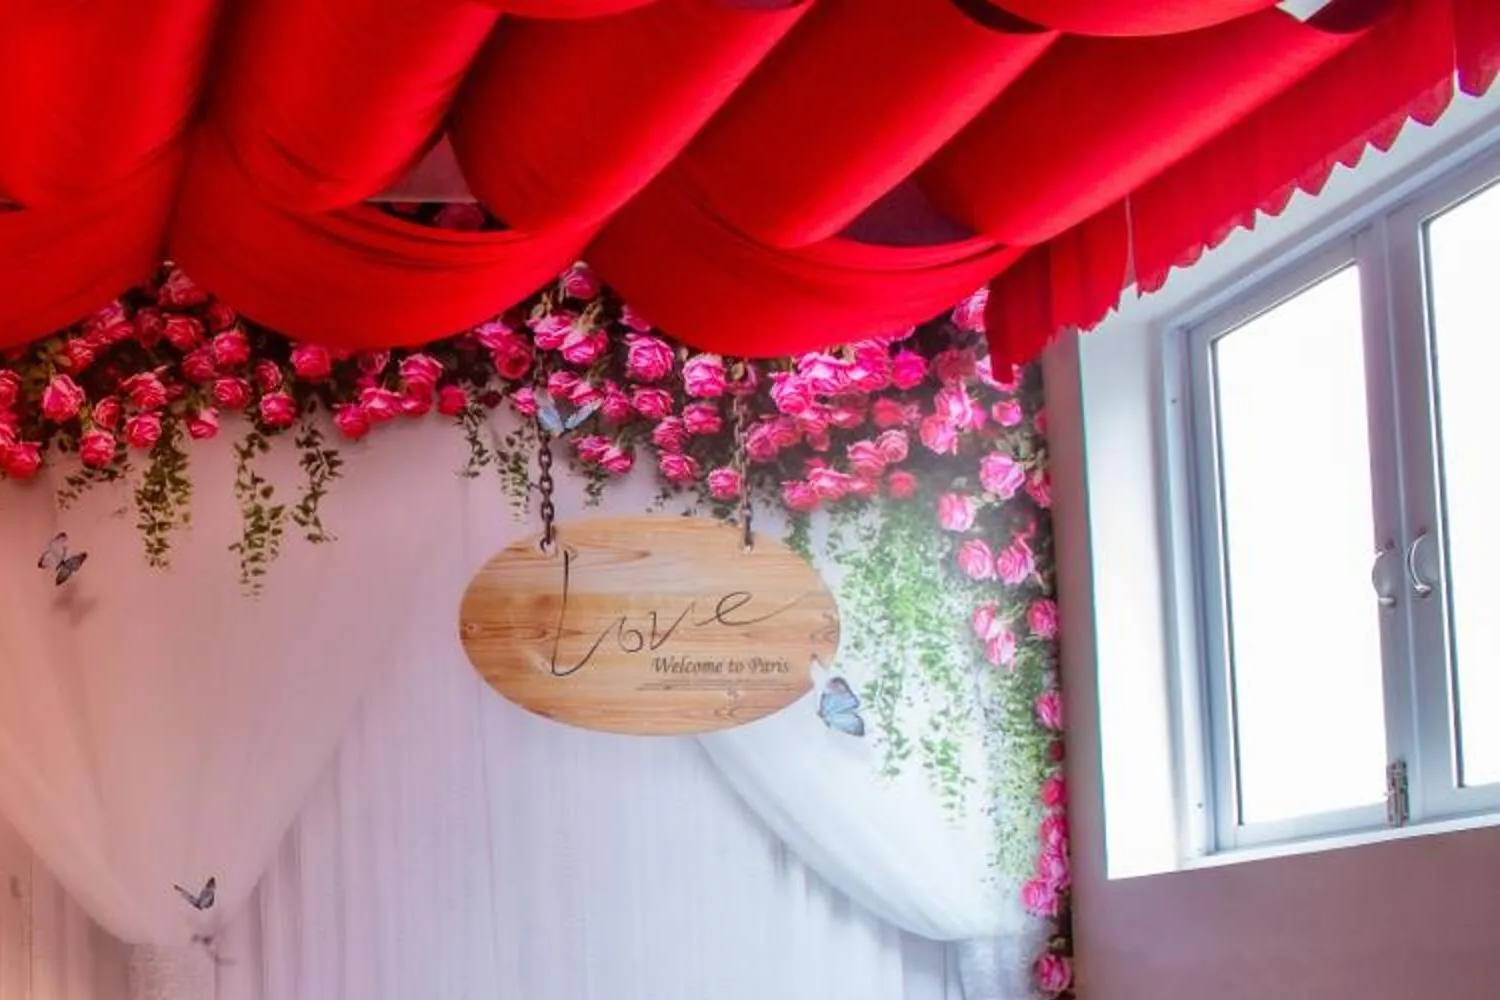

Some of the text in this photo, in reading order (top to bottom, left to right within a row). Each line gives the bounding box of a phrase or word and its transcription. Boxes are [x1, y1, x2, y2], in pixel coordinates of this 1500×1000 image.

[551, 550, 802, 676] Love
[651, 655, 790, 674] Welcome to Paris
